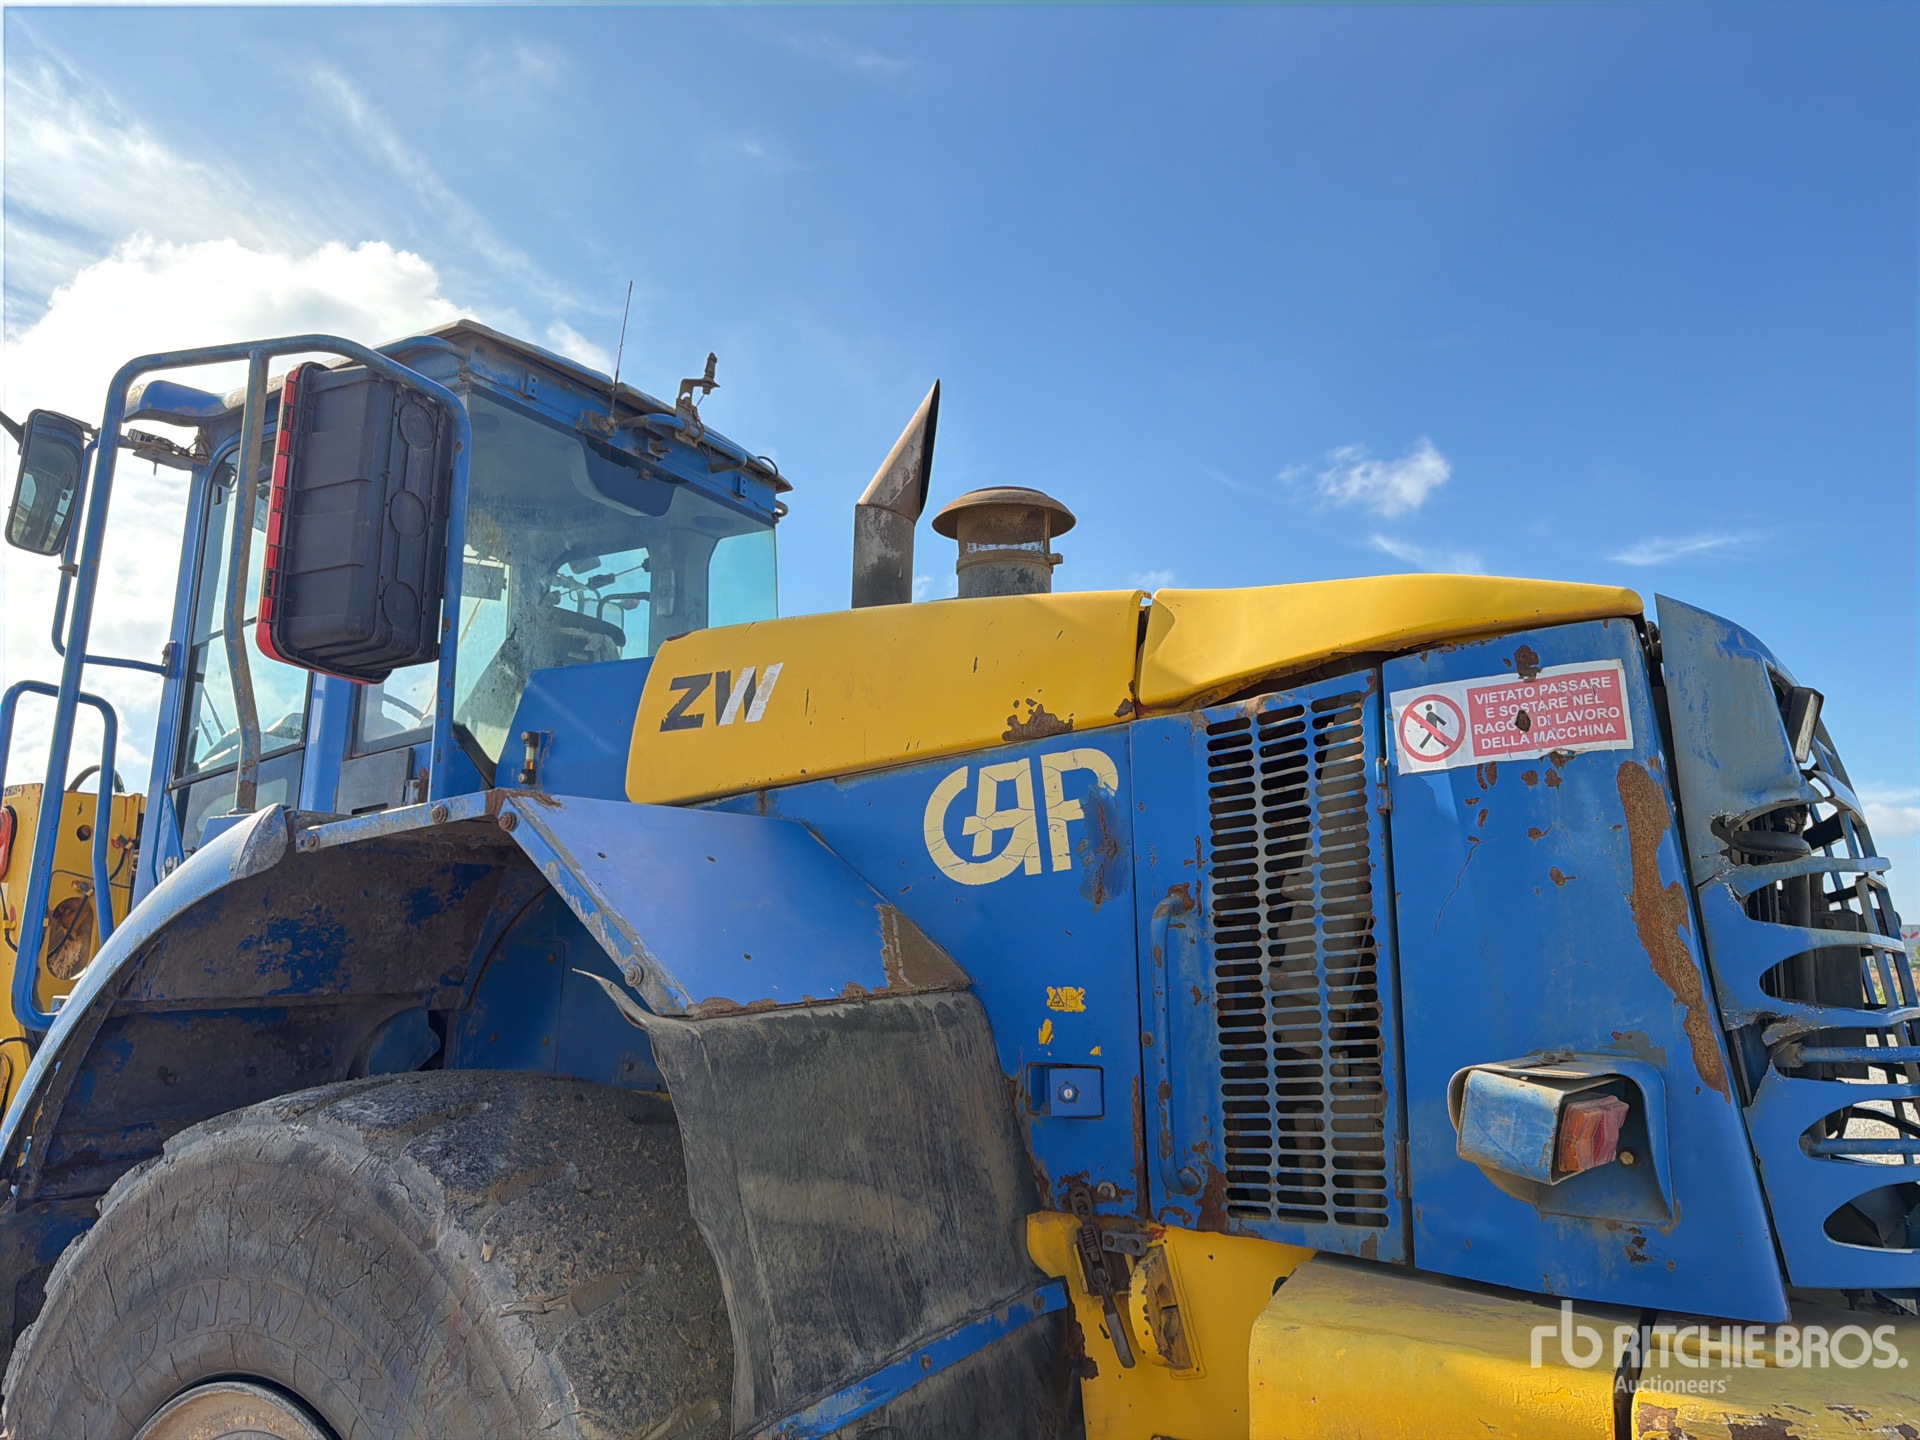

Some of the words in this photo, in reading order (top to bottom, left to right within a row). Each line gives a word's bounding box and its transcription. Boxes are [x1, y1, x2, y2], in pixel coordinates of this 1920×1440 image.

[659, 662, 784, 732] ZW
[1474, 687, 1535, 705] VIETATO
[1539, 676, 1611, 695] PASSARE
[1485, 707, 1495, 718] E
[1499, 697, 1568, 717] SOSTARE
[1572, 693, 1604, 706] NEL
[1537, 714, 1551, 727] DI
[1555, 706, 1620, 724] LAVORO
[1481, 734, 1530, 749] DELLA
[1533, 722, 1616, 743] MACCHINA
